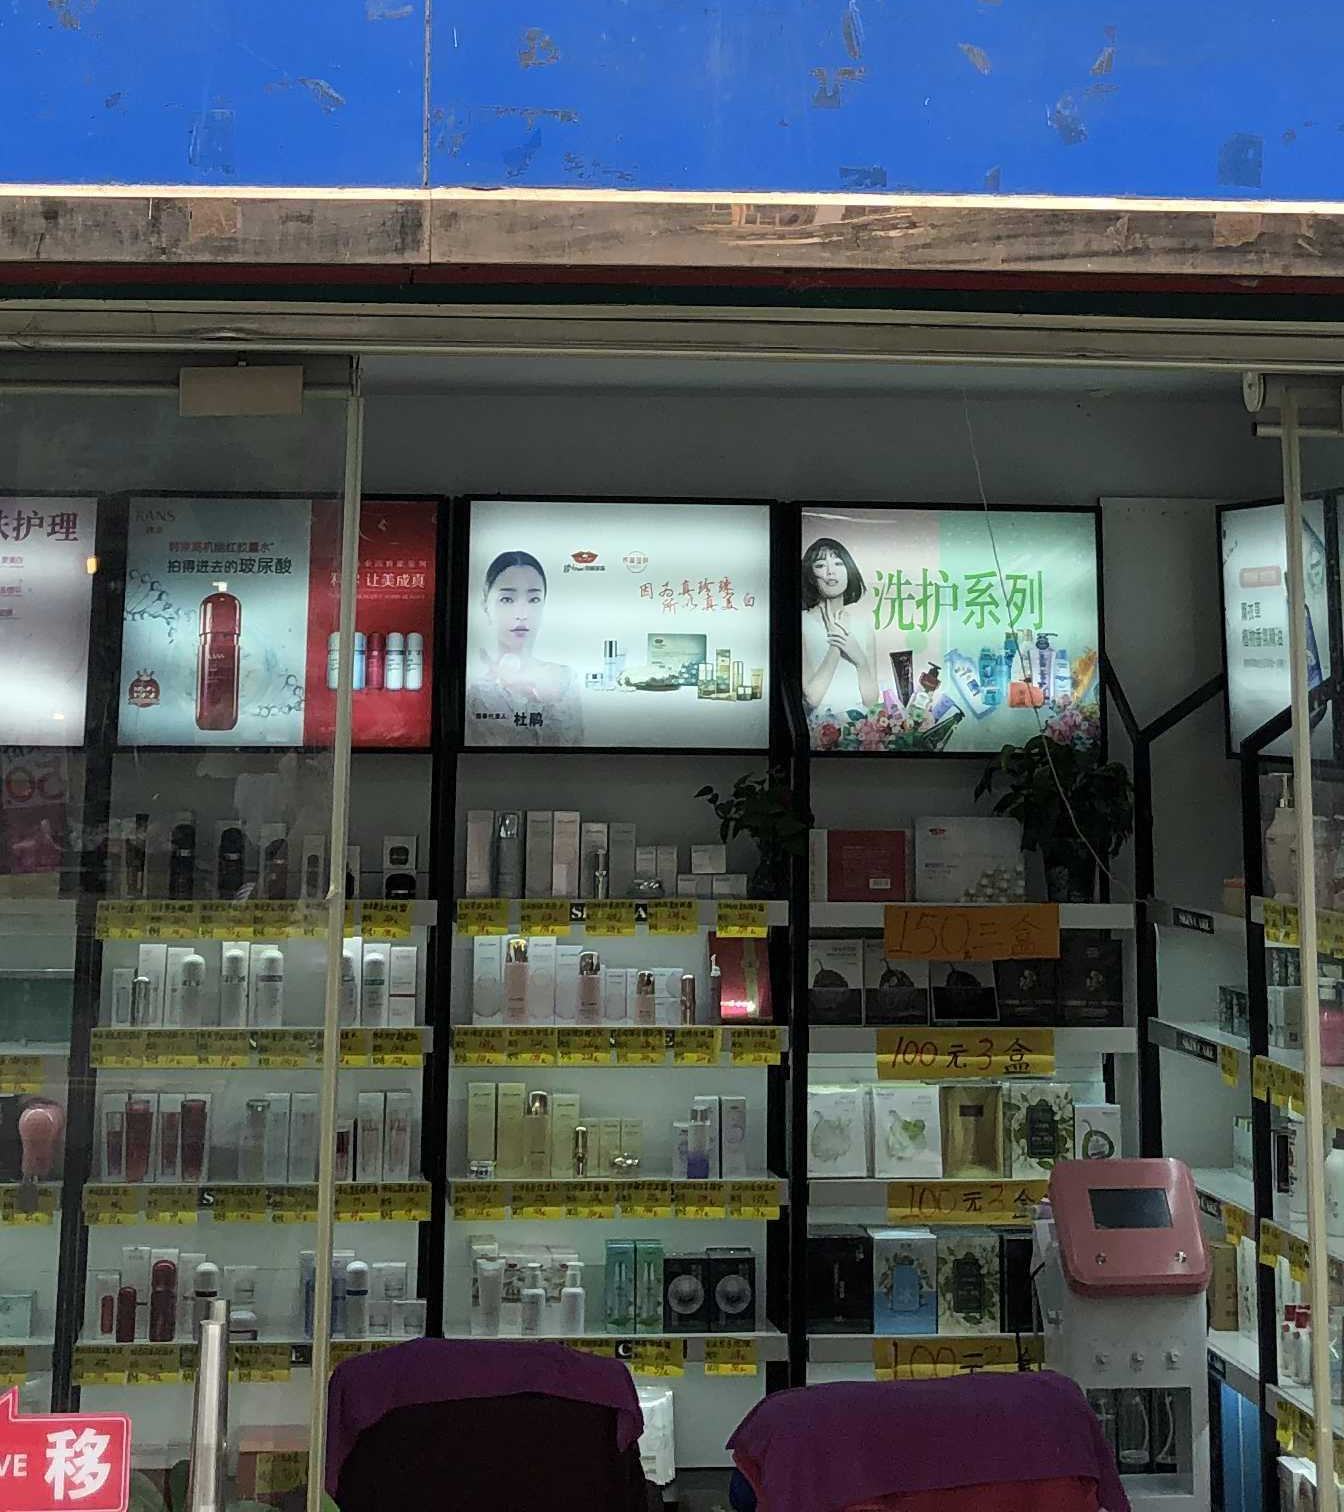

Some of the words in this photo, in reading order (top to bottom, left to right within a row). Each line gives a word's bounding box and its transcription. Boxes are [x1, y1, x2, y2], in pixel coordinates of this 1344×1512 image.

[872, 568, 1043, 632] 洗护系列
[44, 1427, 111, 1501] 移
